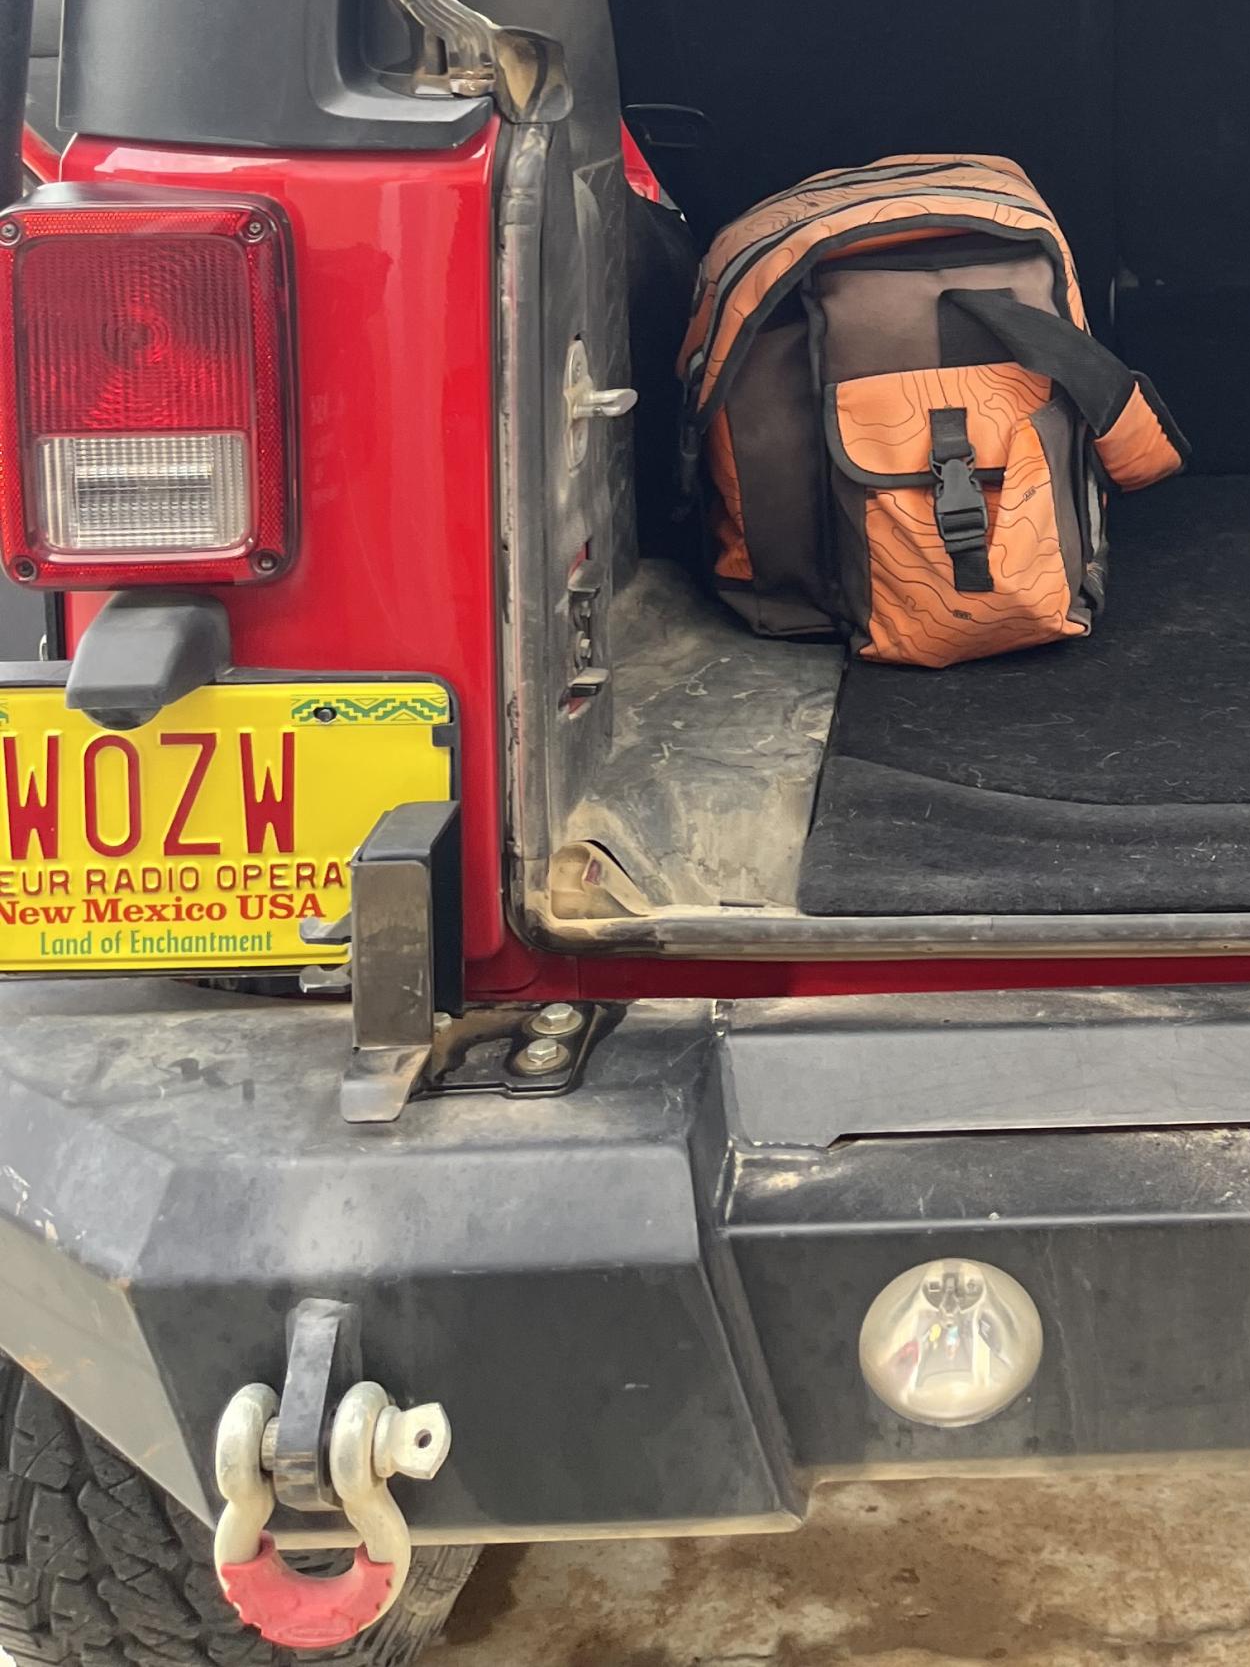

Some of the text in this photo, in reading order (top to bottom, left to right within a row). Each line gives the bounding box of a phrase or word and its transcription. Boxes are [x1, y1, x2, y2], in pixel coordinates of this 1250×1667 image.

[86, 866, 199, 895] RADIO
[217, 861, 352, 891] OPERA
[0, 893, 326, 926] New Mexico USA
[40, 929, 273, 956] Land of Enchantment
